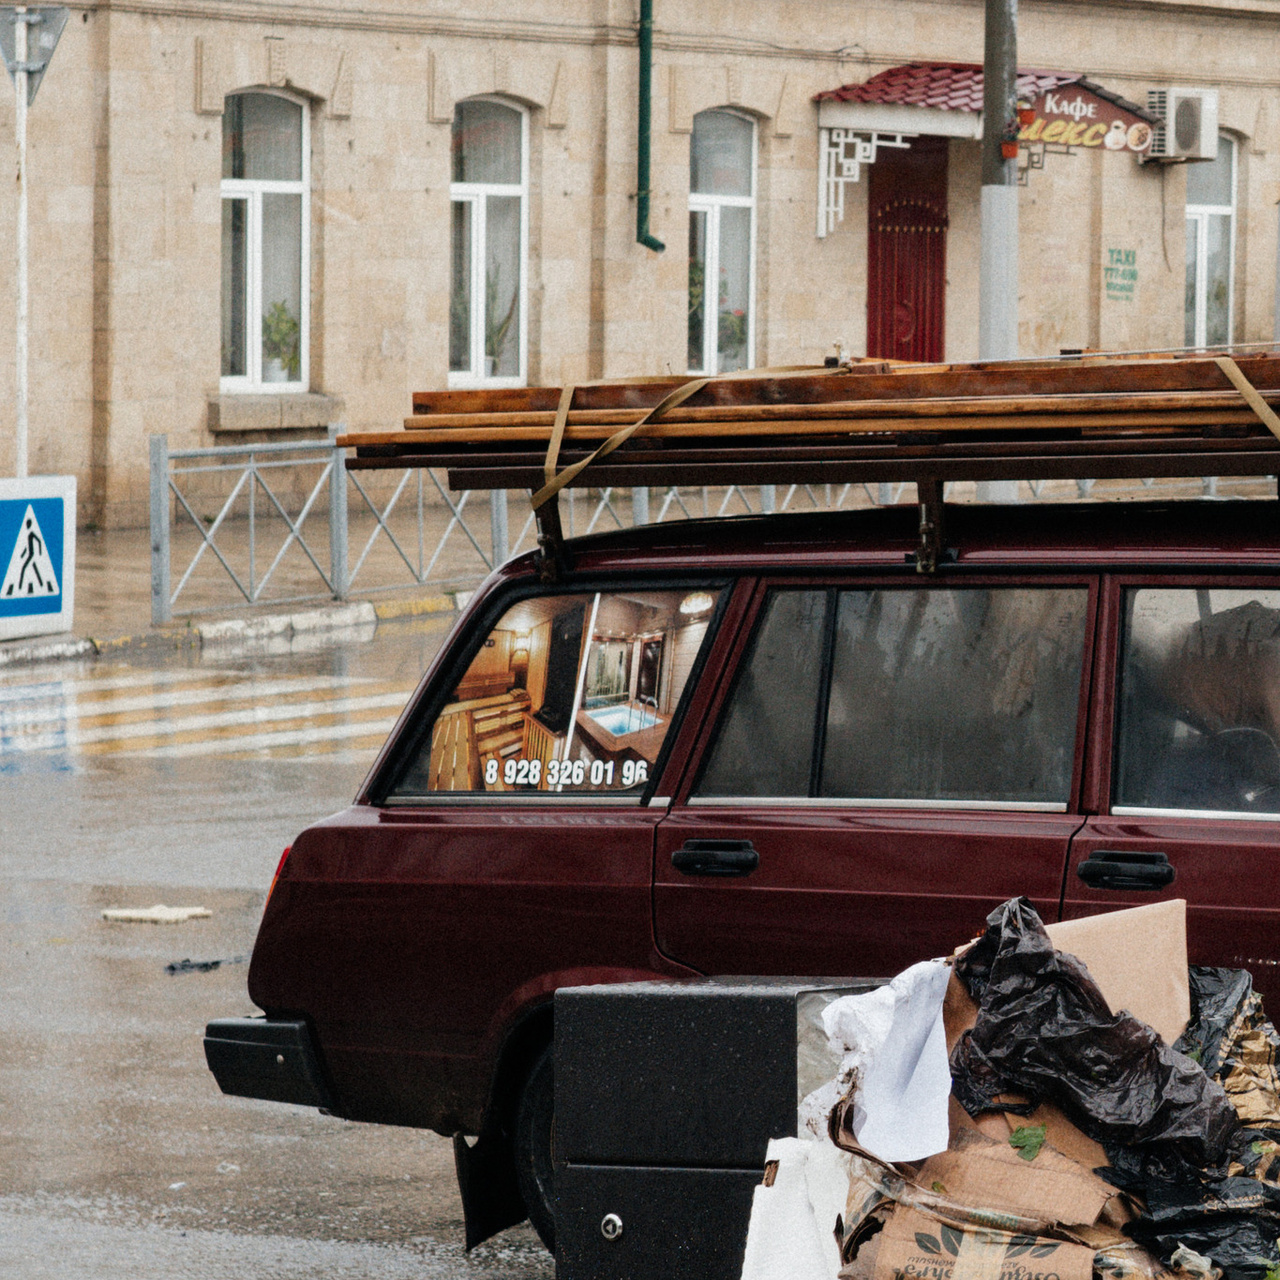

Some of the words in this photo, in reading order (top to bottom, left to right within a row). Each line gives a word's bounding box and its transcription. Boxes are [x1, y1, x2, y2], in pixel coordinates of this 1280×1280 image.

[485, 759, 498, 785] 8
[504, 759, 542, 785] 928
[547, 759, 584, 785] 326
[590, 759, 614, 785] 01
[622, 759, 648, 785] 96
